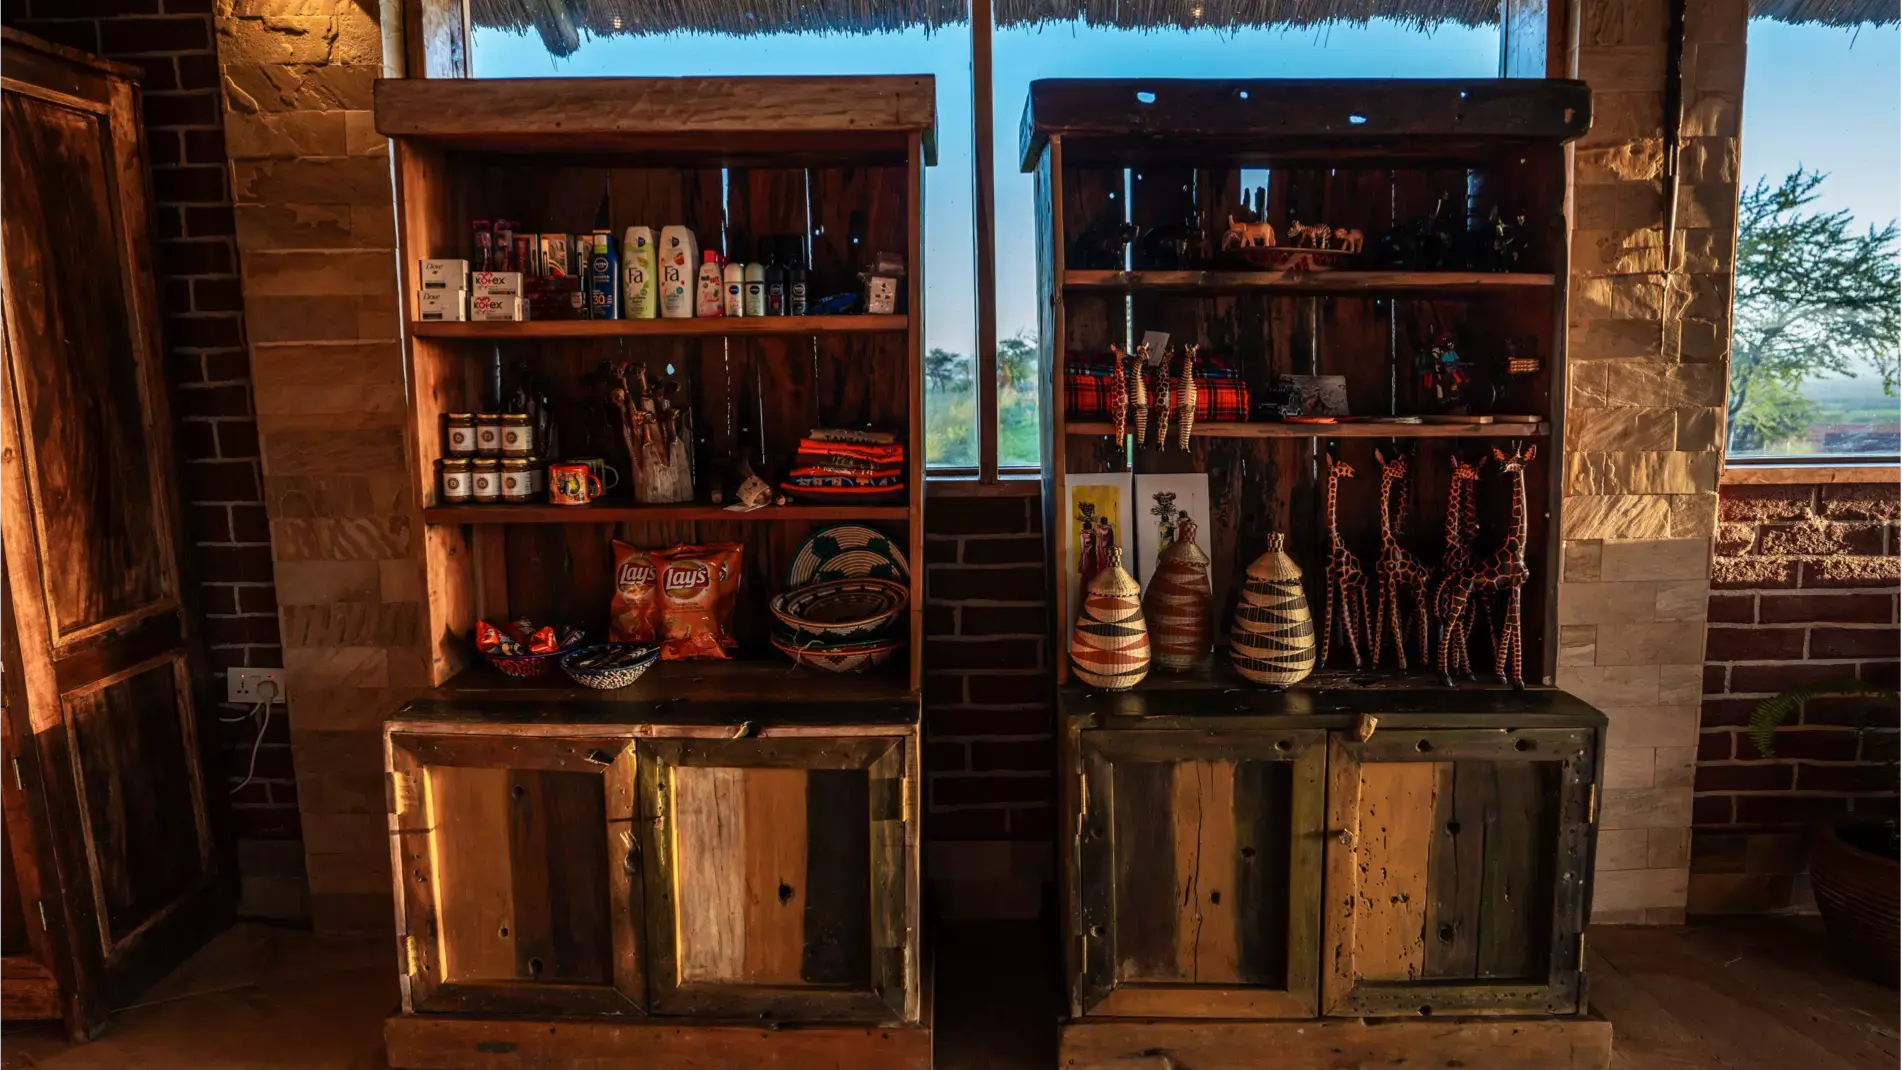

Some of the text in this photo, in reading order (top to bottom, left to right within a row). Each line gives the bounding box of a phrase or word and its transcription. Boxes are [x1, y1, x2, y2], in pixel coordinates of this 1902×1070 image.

[426, 262, 443, 270] Dove
[628, 267, 643, 284] Fa
[664, 265, 679, 282] Fa
[423, 293, 440, 301] Dove
[593, 295, 605, 304] 30
[666, 568, 707, 590] Lay's
